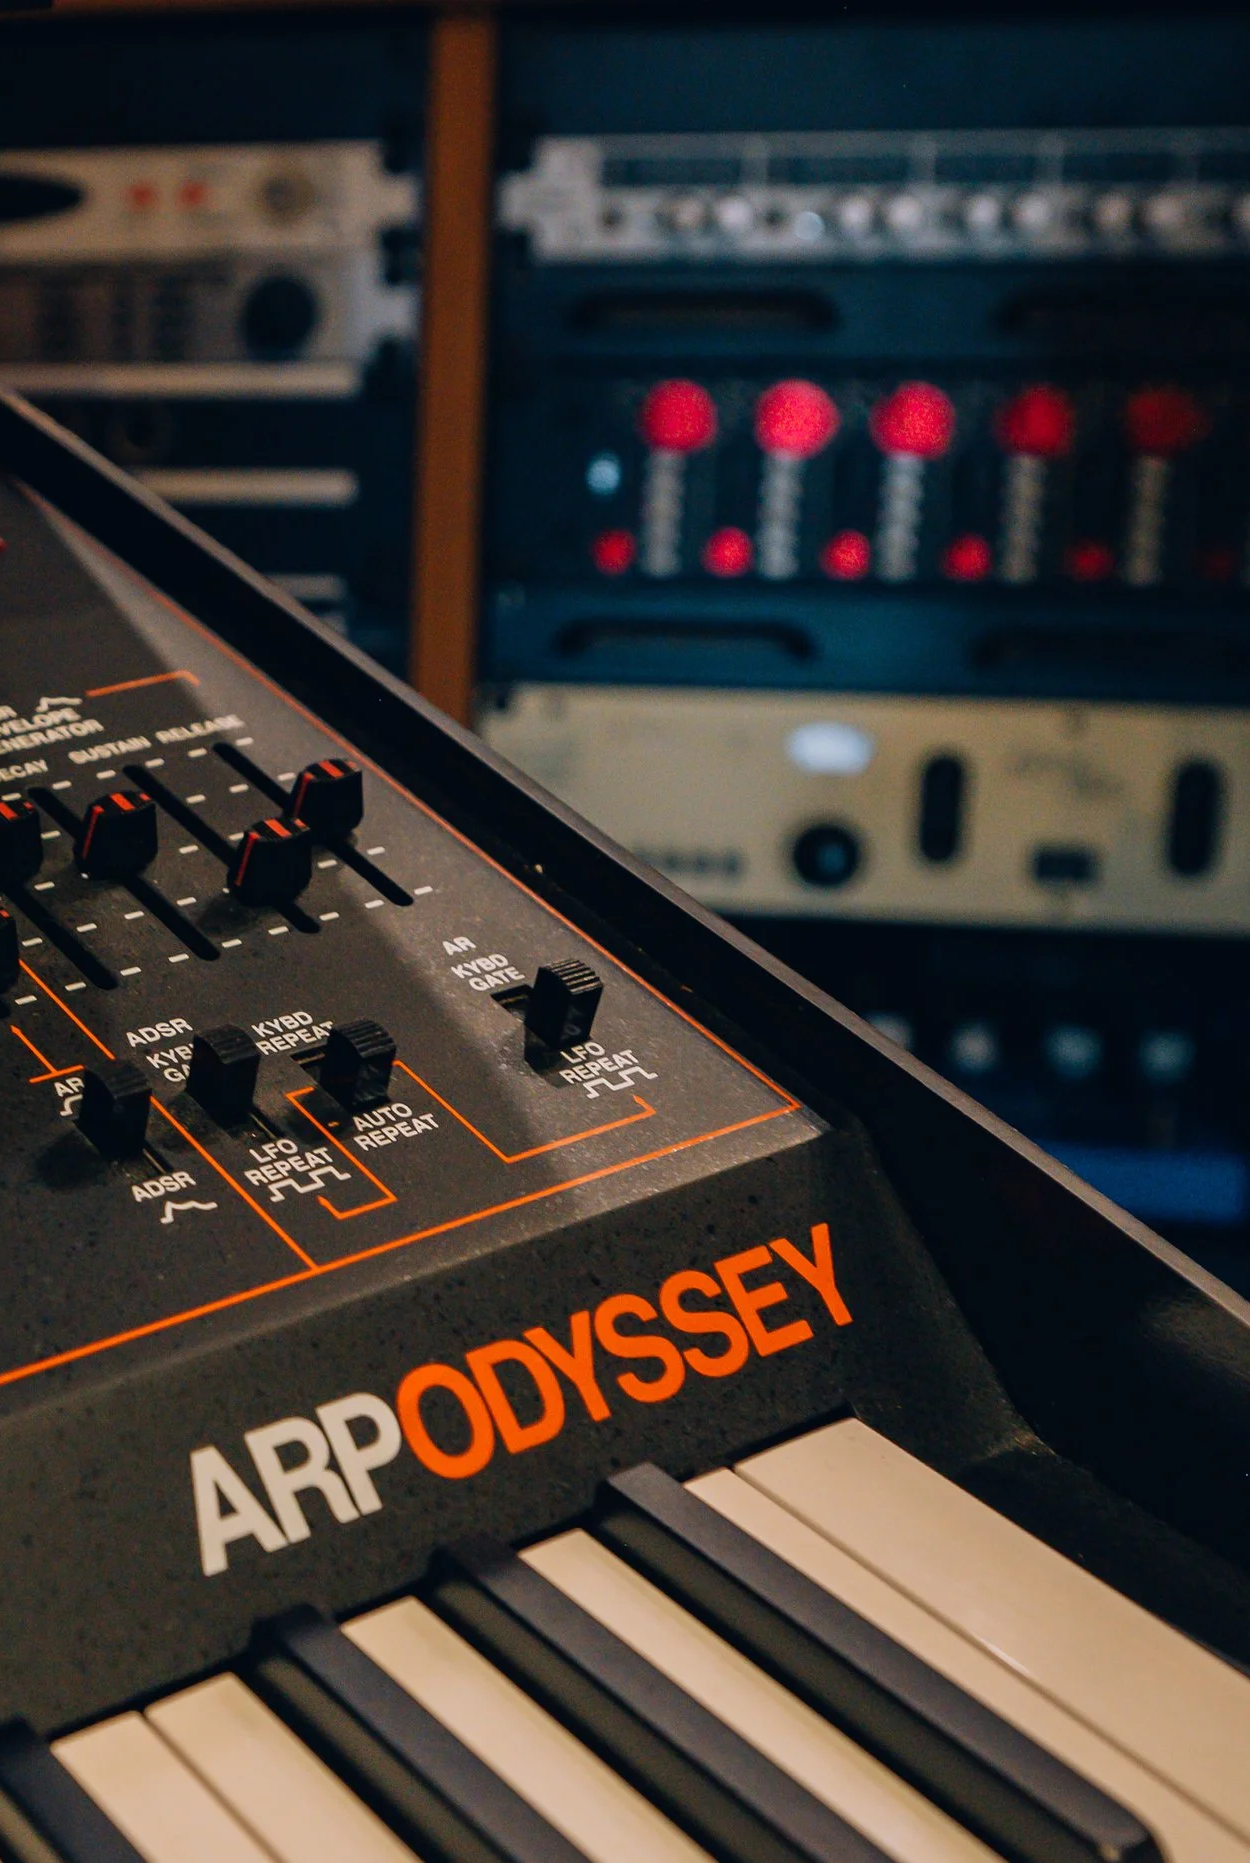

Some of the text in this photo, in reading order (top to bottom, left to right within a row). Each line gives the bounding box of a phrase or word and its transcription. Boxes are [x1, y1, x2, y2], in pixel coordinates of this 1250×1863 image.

[155, 714, 246, 744] RELEASE
[68, 735, 152, 765] SUSTAIN
[442, 936, 477, 956] AR
[450, 953, 510, 980] KYBD
[468, 965, 525, 992] GATE
[126, 1017, 193, 1048] ADSR
[252, 1011, 313, 1038] KYBD
[255, 1021, 334, 1056] REPEAT
[146, 1043, 194, 1069] KYB
[559, 1041, 605, 1065] LFO
[559, 1049, 640, 1085] REPEAT
[352, 1103, 413, 1132] AUTO
[353, 1113, 439, 1151] REPEAT
[244, 1147, 333, 1186] REPEAT
[249, 1139, 298, 1164] LFO
[132, 1170, 197, 1203] ADSR
[189, 1223, 853, 1577] ARP ODYSSEY
